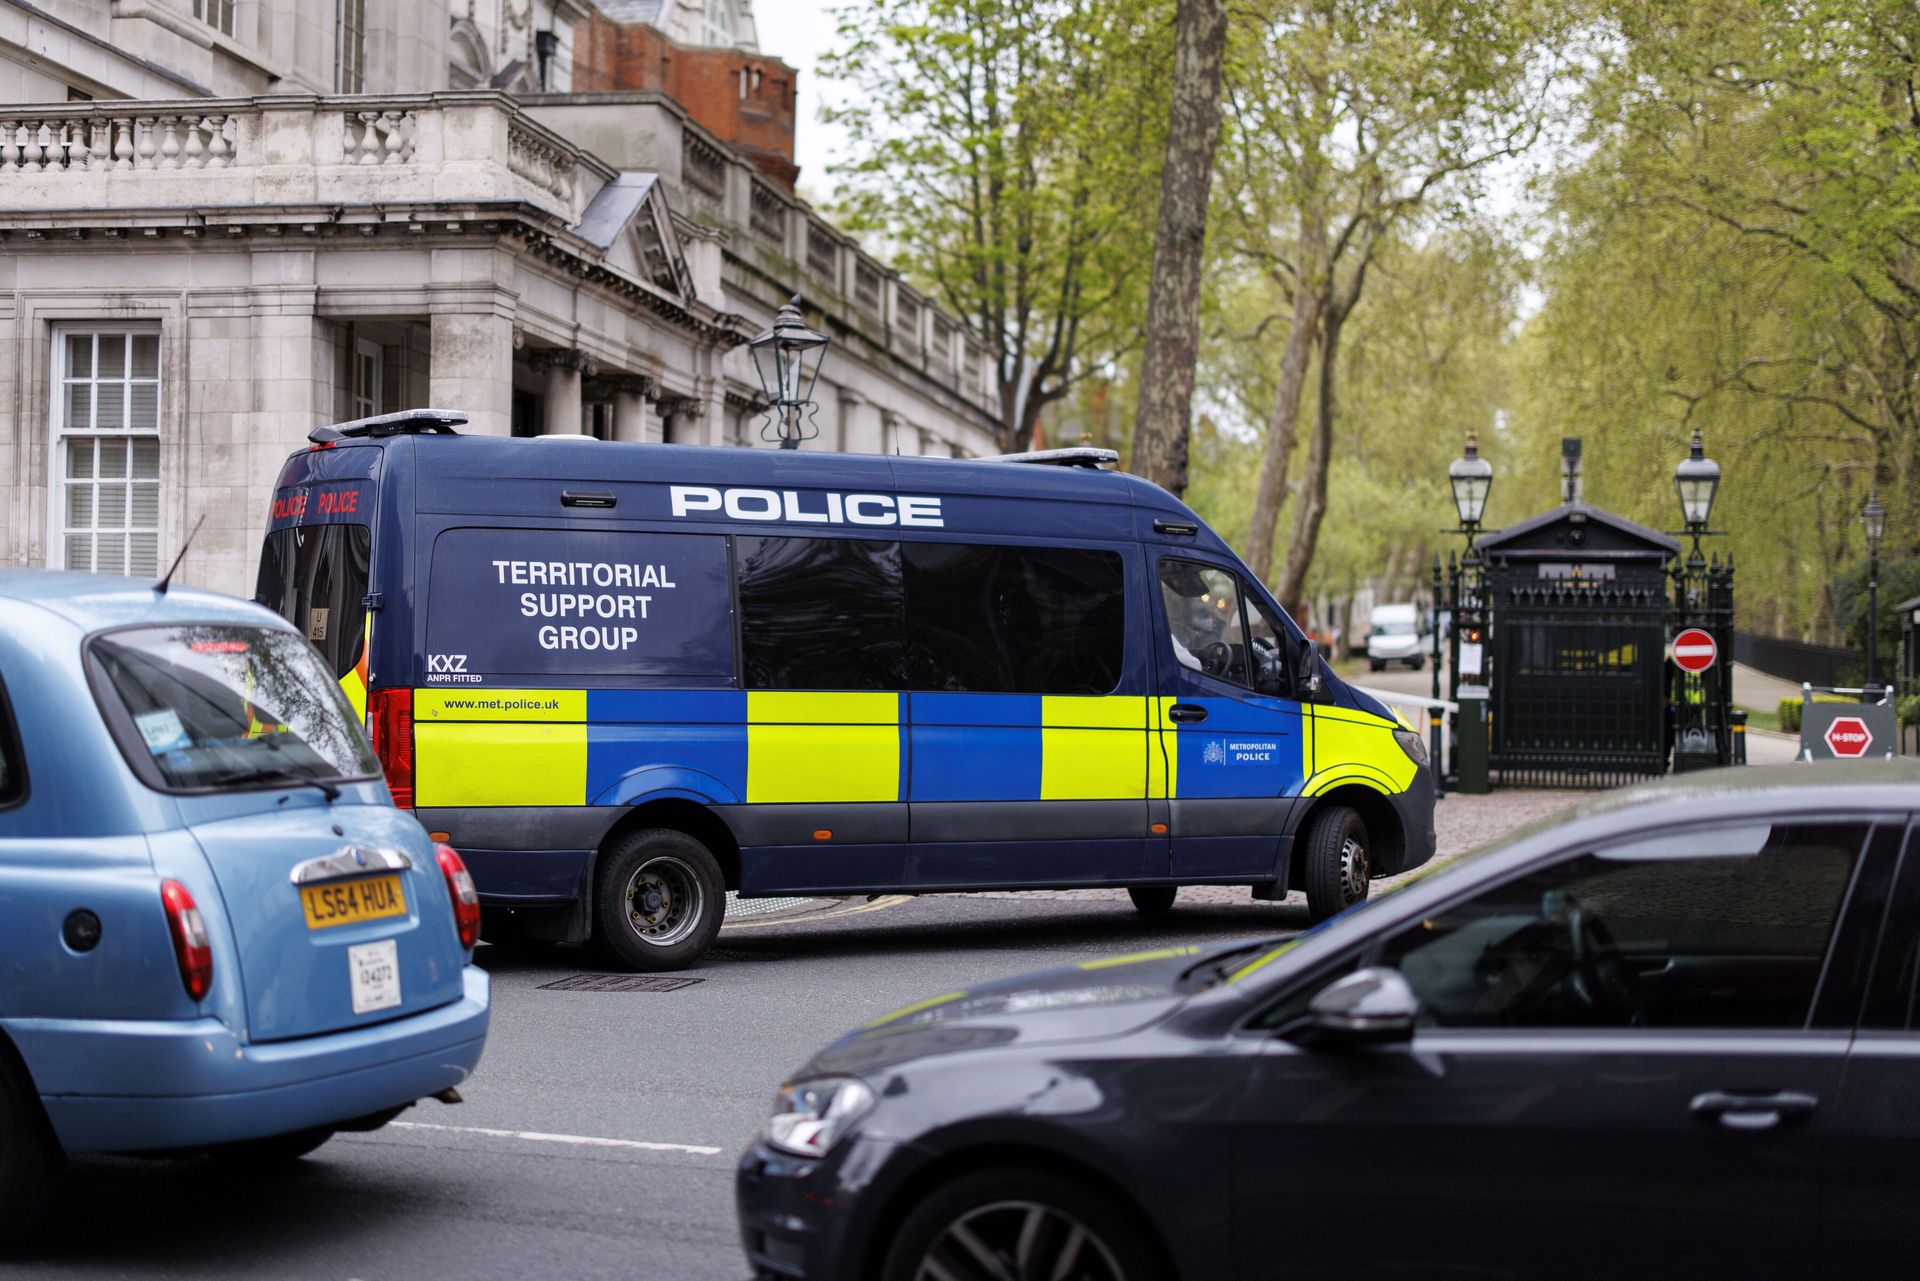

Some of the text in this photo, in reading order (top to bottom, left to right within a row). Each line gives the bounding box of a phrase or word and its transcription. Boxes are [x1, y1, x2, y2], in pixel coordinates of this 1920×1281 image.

[317, 491, 360, 514] POLICE
[669, 485, 945, 528] POLICE
[492, 560, 677, 588] TERRITORIAL
[520, 592, 652, 618] SUPPORT
[316, 611, 323, 623] U
[312, 626, 324, 638] 415
[538, 625, 639, 650] GROUP
[427, 654, 468, 673] KXZ
[427, 674, 482, 683] ANPR FITTED
[444, 699, 560, 711] www.met.police.uk
[1229, 743, 1276, 751] METROPOLITAN
[1236, 753, 1270, 761] POLICE
[360, 881, 398, 912] HUA
